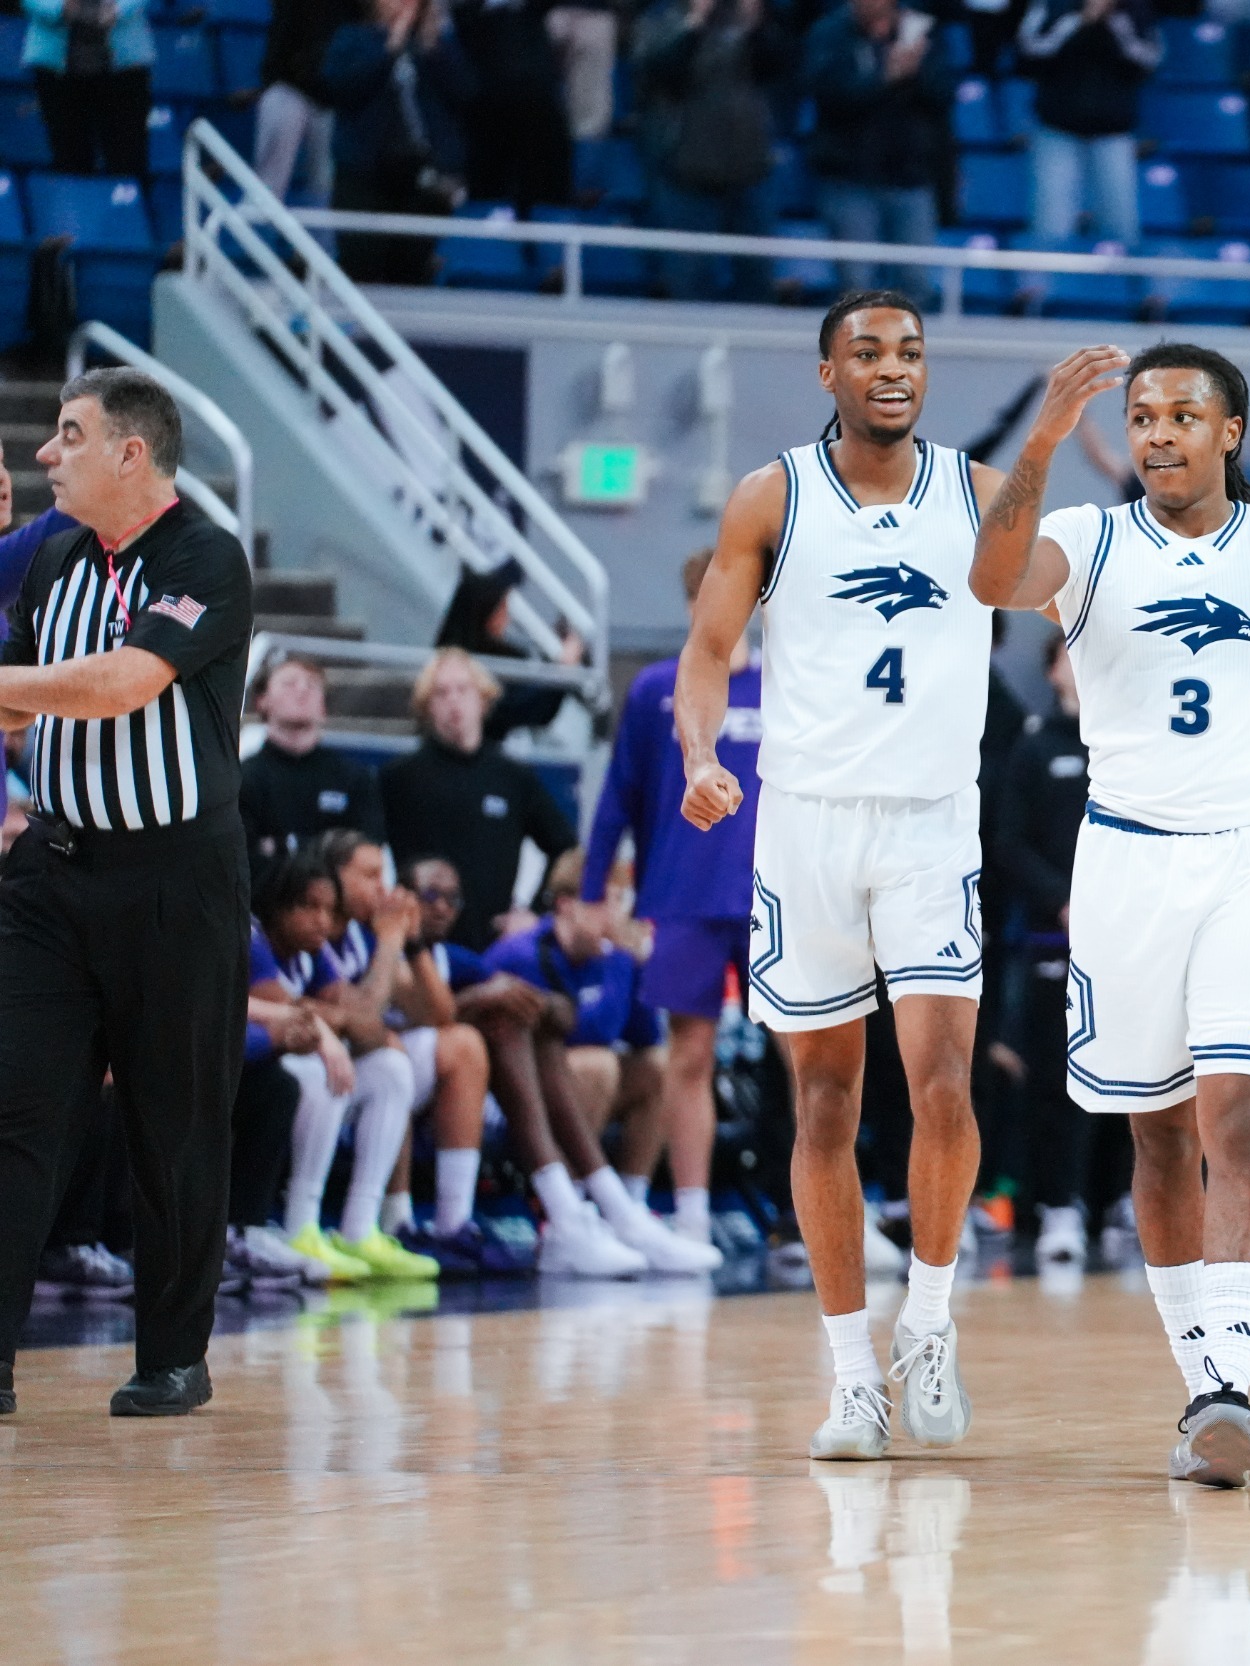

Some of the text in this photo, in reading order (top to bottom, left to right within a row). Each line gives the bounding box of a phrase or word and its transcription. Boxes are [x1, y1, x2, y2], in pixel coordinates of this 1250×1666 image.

[108, 620, 125, 637] TW
[864, 645, 907, 706] 4
[1168, 676, 1213, 738] 3
